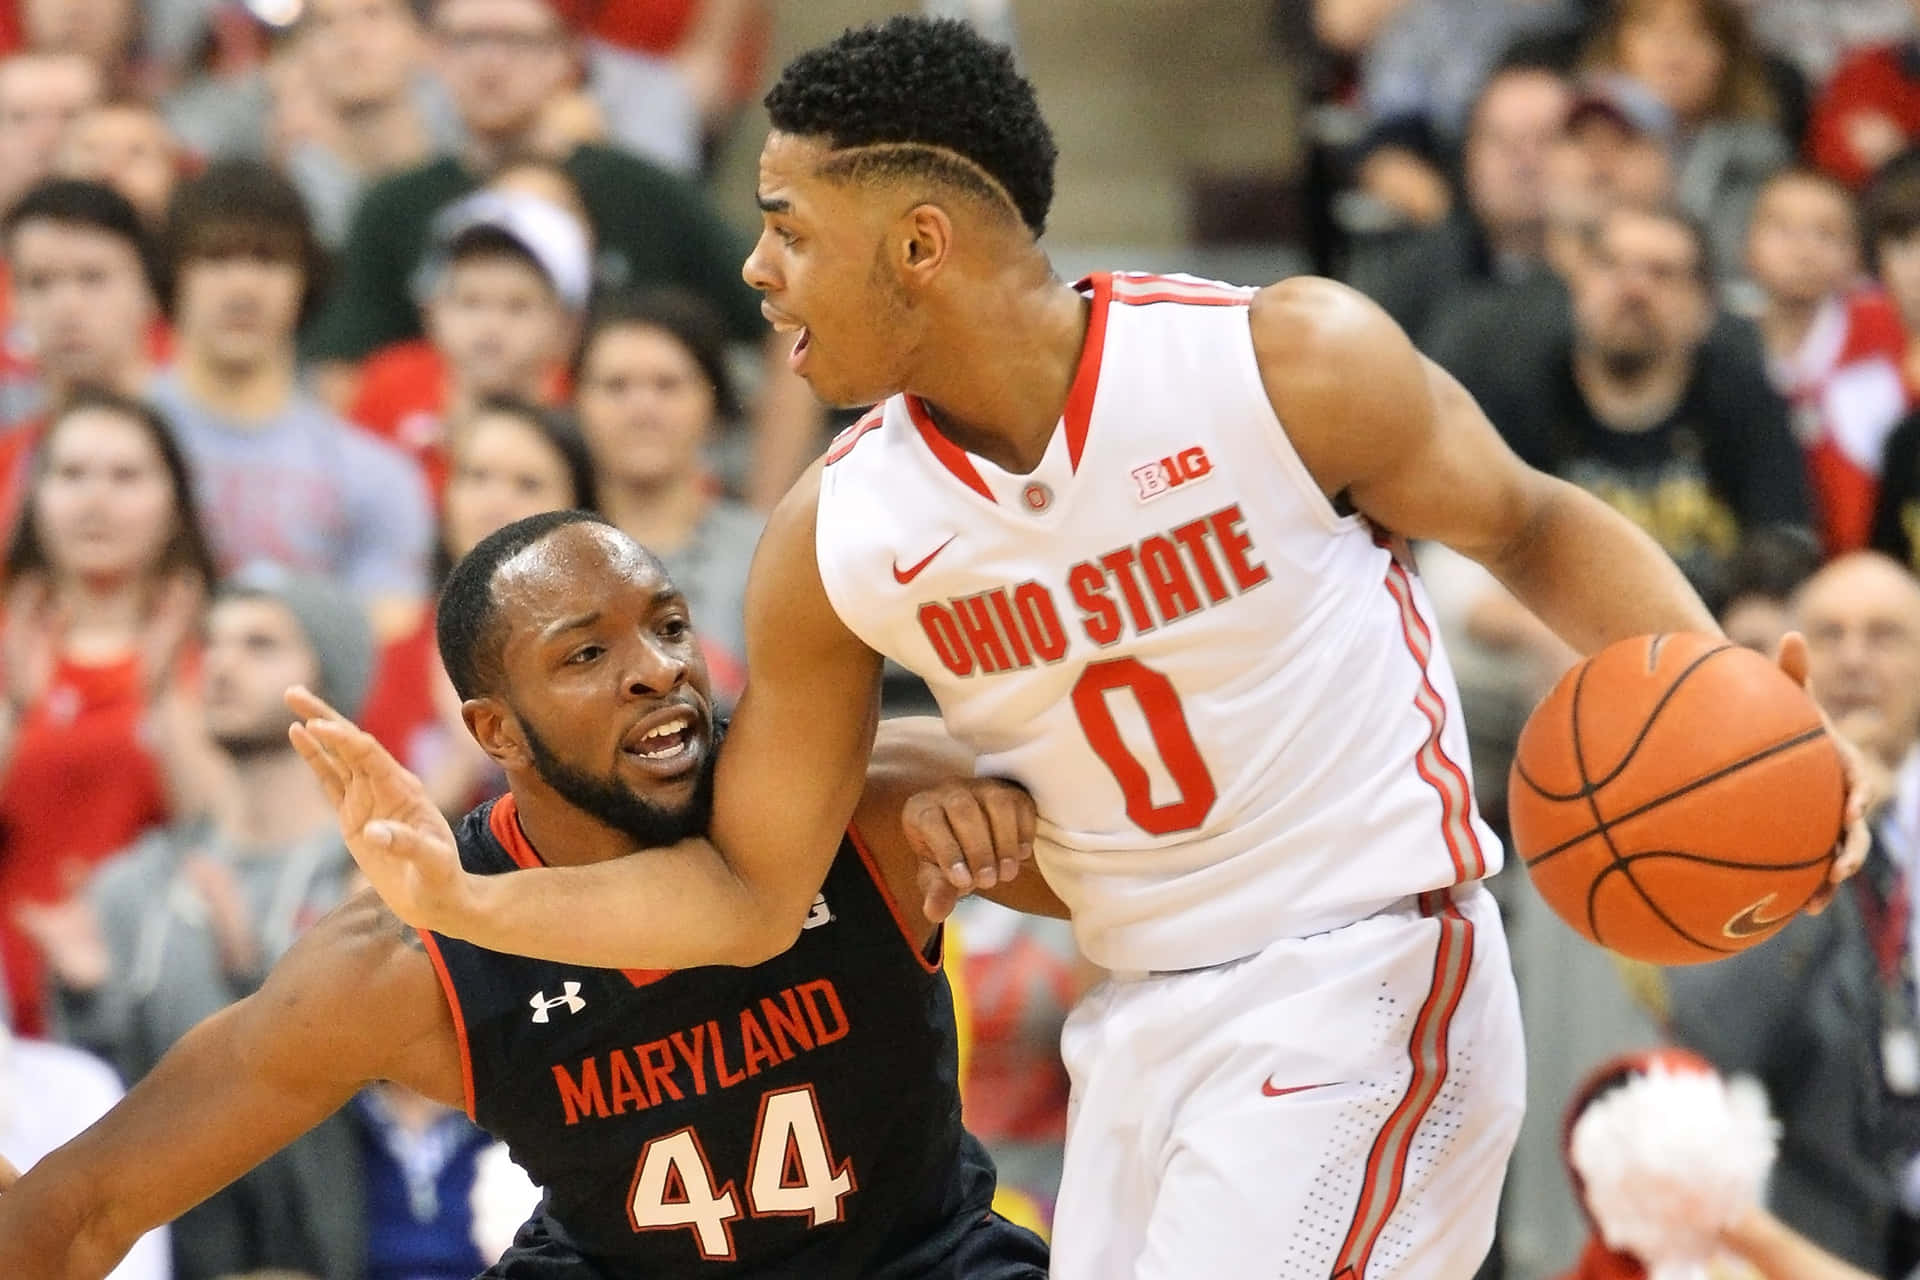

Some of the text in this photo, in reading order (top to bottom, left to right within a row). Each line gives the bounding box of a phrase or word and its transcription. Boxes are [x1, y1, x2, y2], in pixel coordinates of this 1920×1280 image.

[917, 502, 1273, 678] OHIO STATE
[551, 977, 850, 1126] MARYLAND
[625, 1082, 858, 1262] 44
